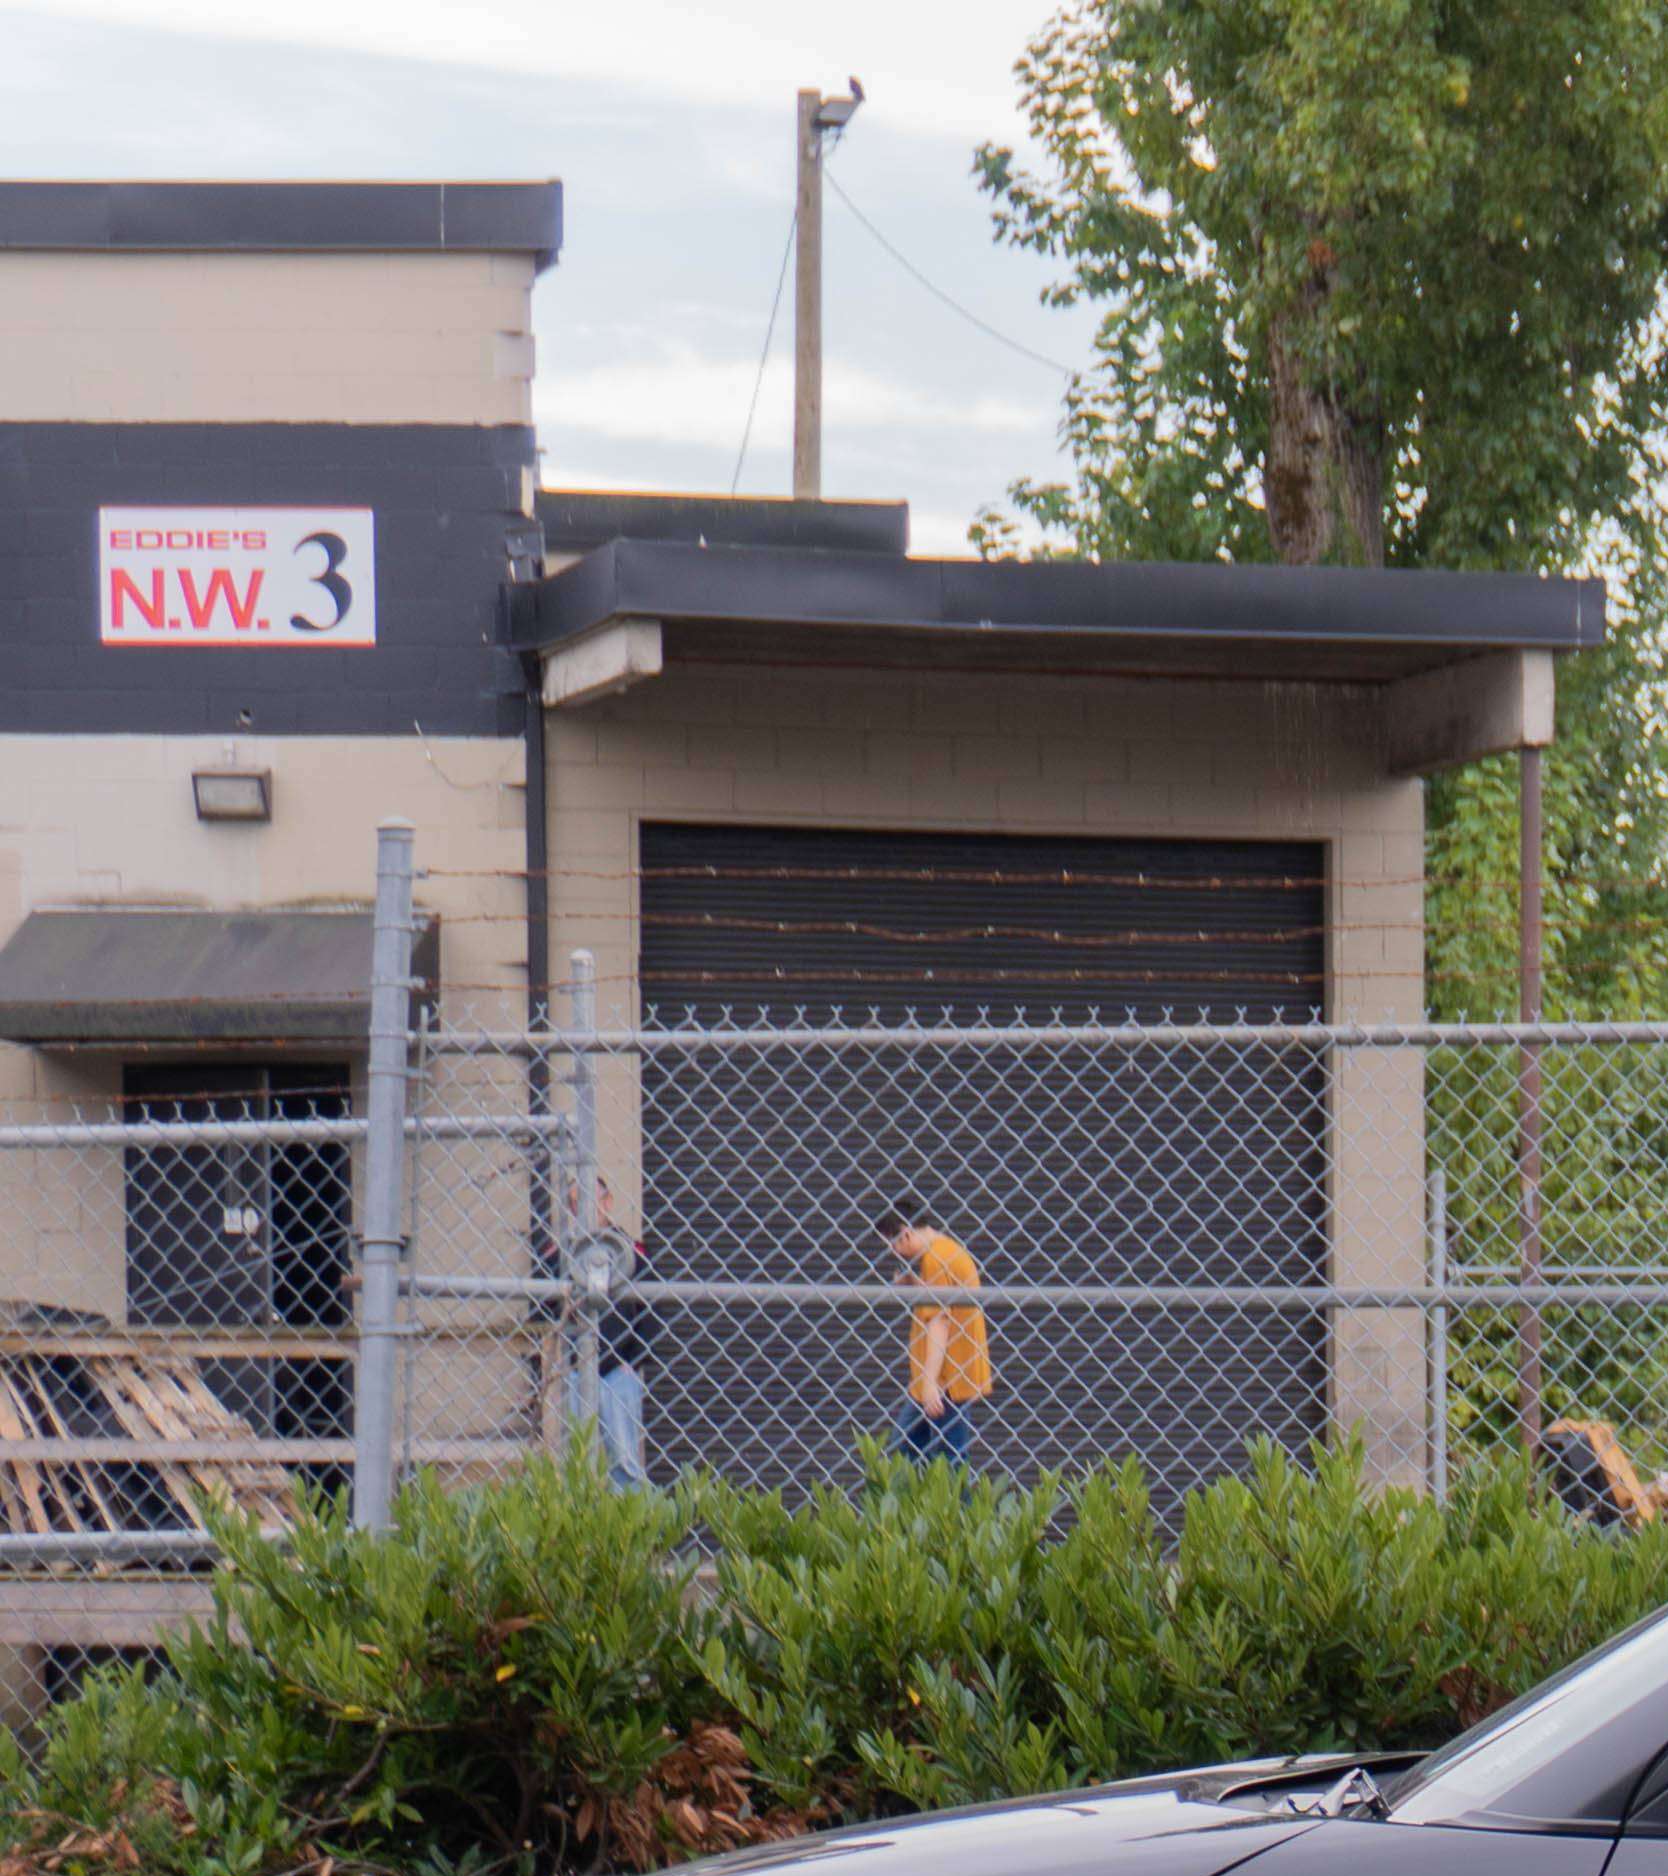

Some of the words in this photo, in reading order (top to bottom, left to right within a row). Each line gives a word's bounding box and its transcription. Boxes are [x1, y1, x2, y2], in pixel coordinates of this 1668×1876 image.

[109, 530, 267, 550] EDDIE'S
[110, 567, 270, 631] N.W.
[289, 531, 353, 632] 3
